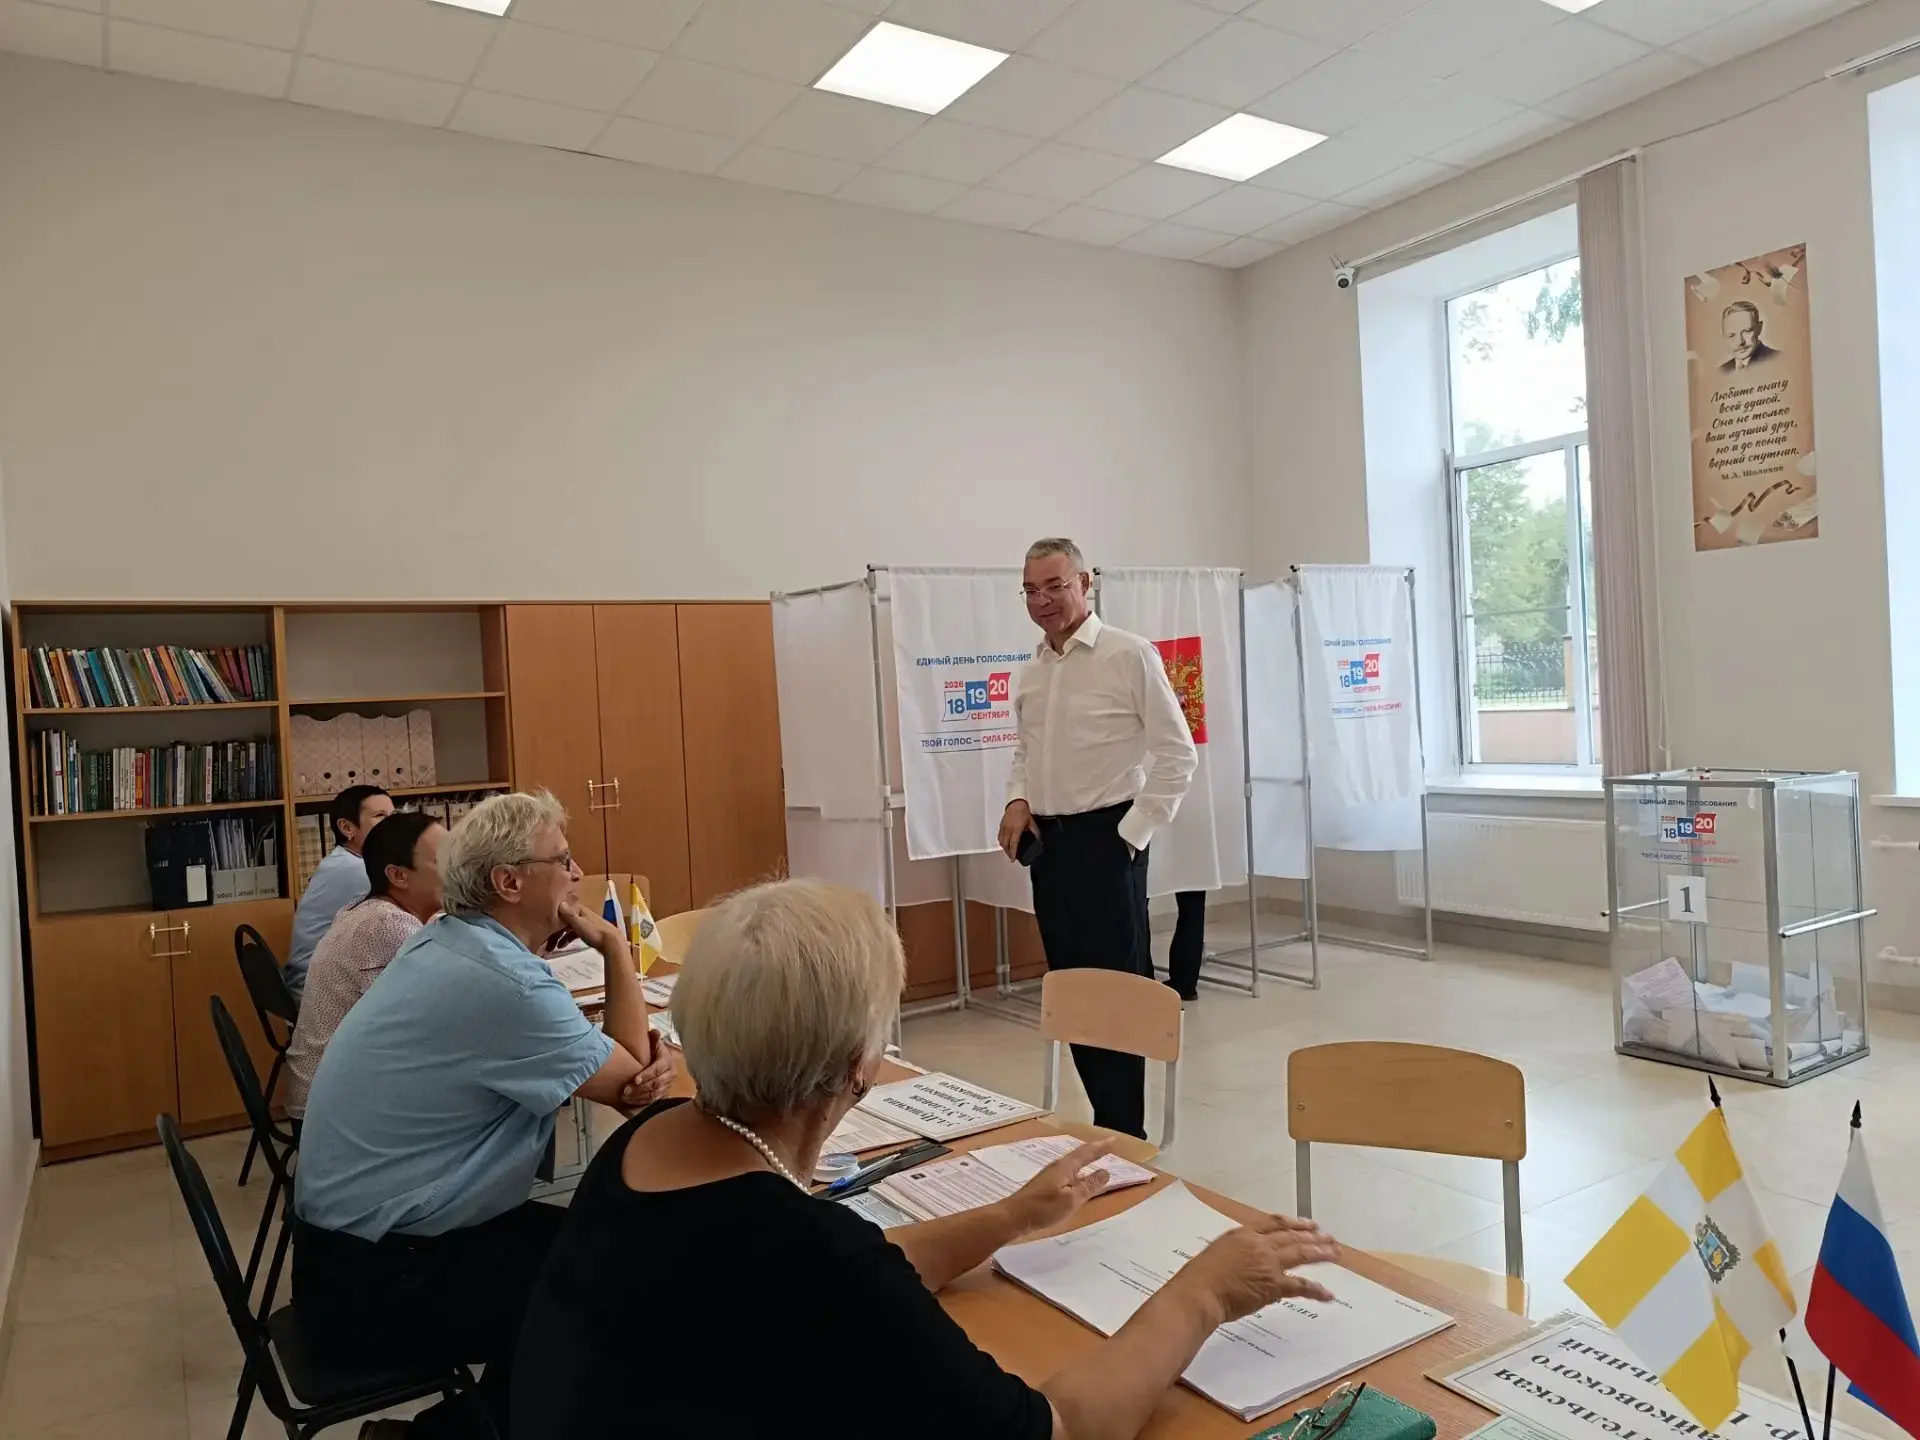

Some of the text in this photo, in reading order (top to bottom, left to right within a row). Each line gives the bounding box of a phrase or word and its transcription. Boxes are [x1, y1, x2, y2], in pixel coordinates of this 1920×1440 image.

[1710, 379, 1789, 403] Любите книгу
[1719, 392, 1780, 414] всей душой.
[1712, 406, 1790, 430] Она не только
[1705, 419, 1798, 443] ваш лучший друг,
[1716, 435, 1787, 455] но и до конца
[1748, 447, 1800, 465] спутник.
[1743, 466, 1784, 477] Шолохов
[916, 653, 1032, 667] ЕДИНЫЙ ДЕНЬ ГОЛОСОВАНИЯ
[944, 680, 964, 689] 2026
[1339, 659, 1377, 688] 18 19 20
[947, 679, 1007, 715] 18 19 20
[970, 709, 1010, 720] СЕНТЯБРЯ
[921, 737, 942, 748] ТВОЙ
[943, 737, 972, 747] ГОЛОС
[982, 734, 1001, 744] СИЛА
[1686, 799, 1738, 807] ГОЛОСОВАНИЯ
[1663, 817, 1713, 839] 18 19 20
[1679, 886, 1694, 913] 1
[1493, 1368, 1653, 1440] тельская
[1531, 1354, 1722, 1440] айковского
